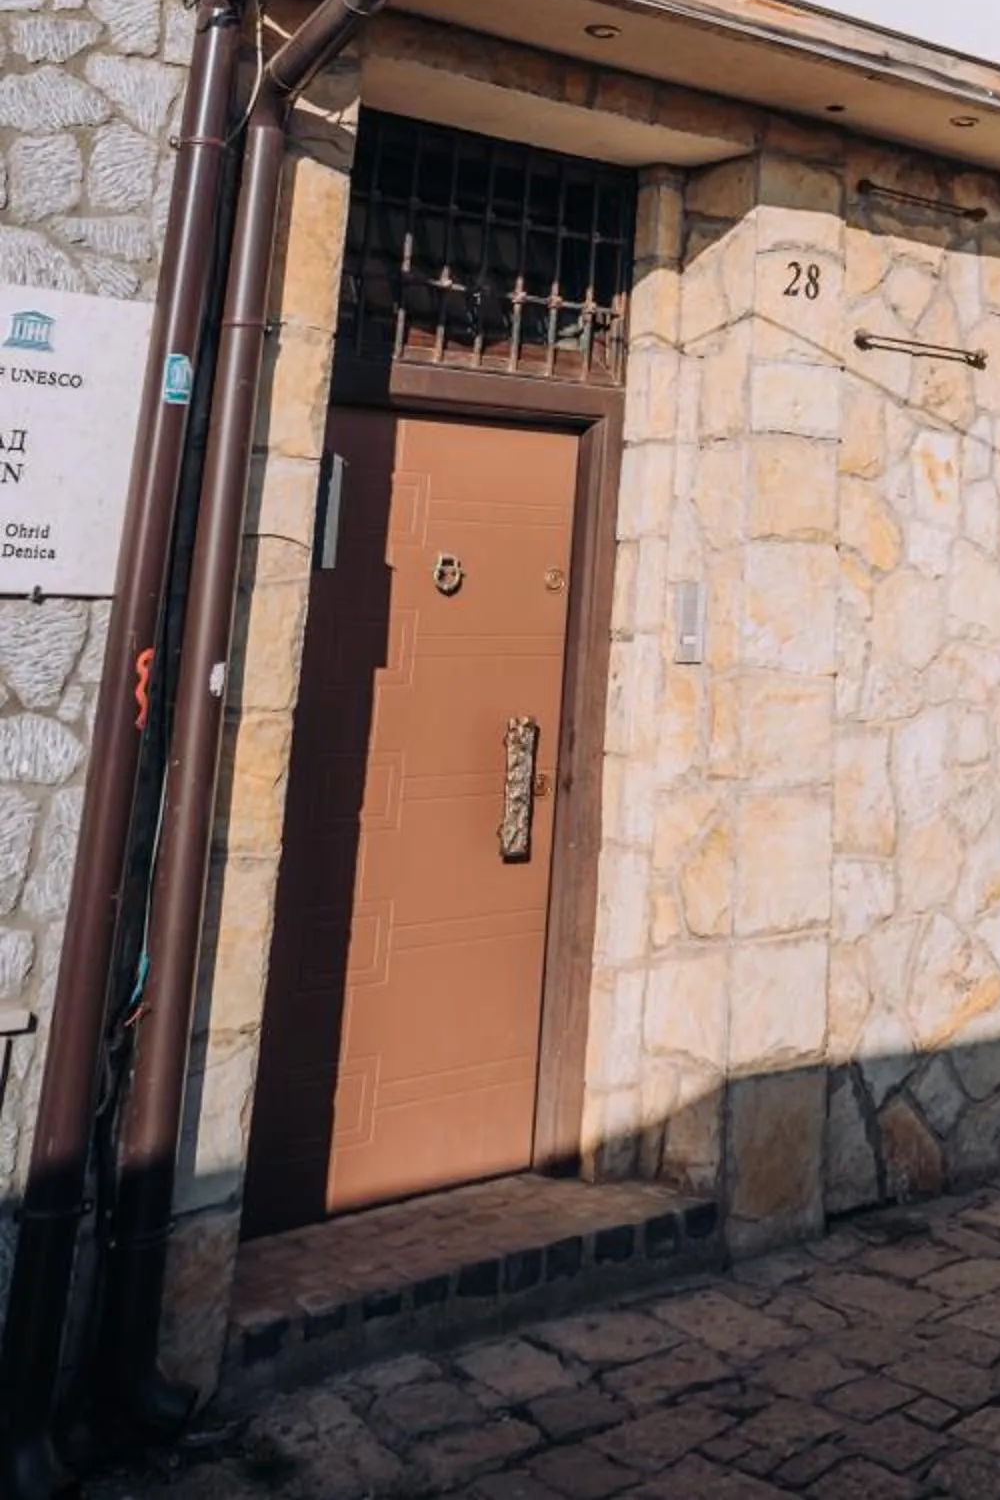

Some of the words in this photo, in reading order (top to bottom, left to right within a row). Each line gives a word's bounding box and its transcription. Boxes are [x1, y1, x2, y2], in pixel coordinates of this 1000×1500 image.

[783, 261, 819, 300] 28
[10, 367, 83, 388] UNESCO
[5, 523, 51, 539] Ohrid
[1, 543, 56, 560] Denica
